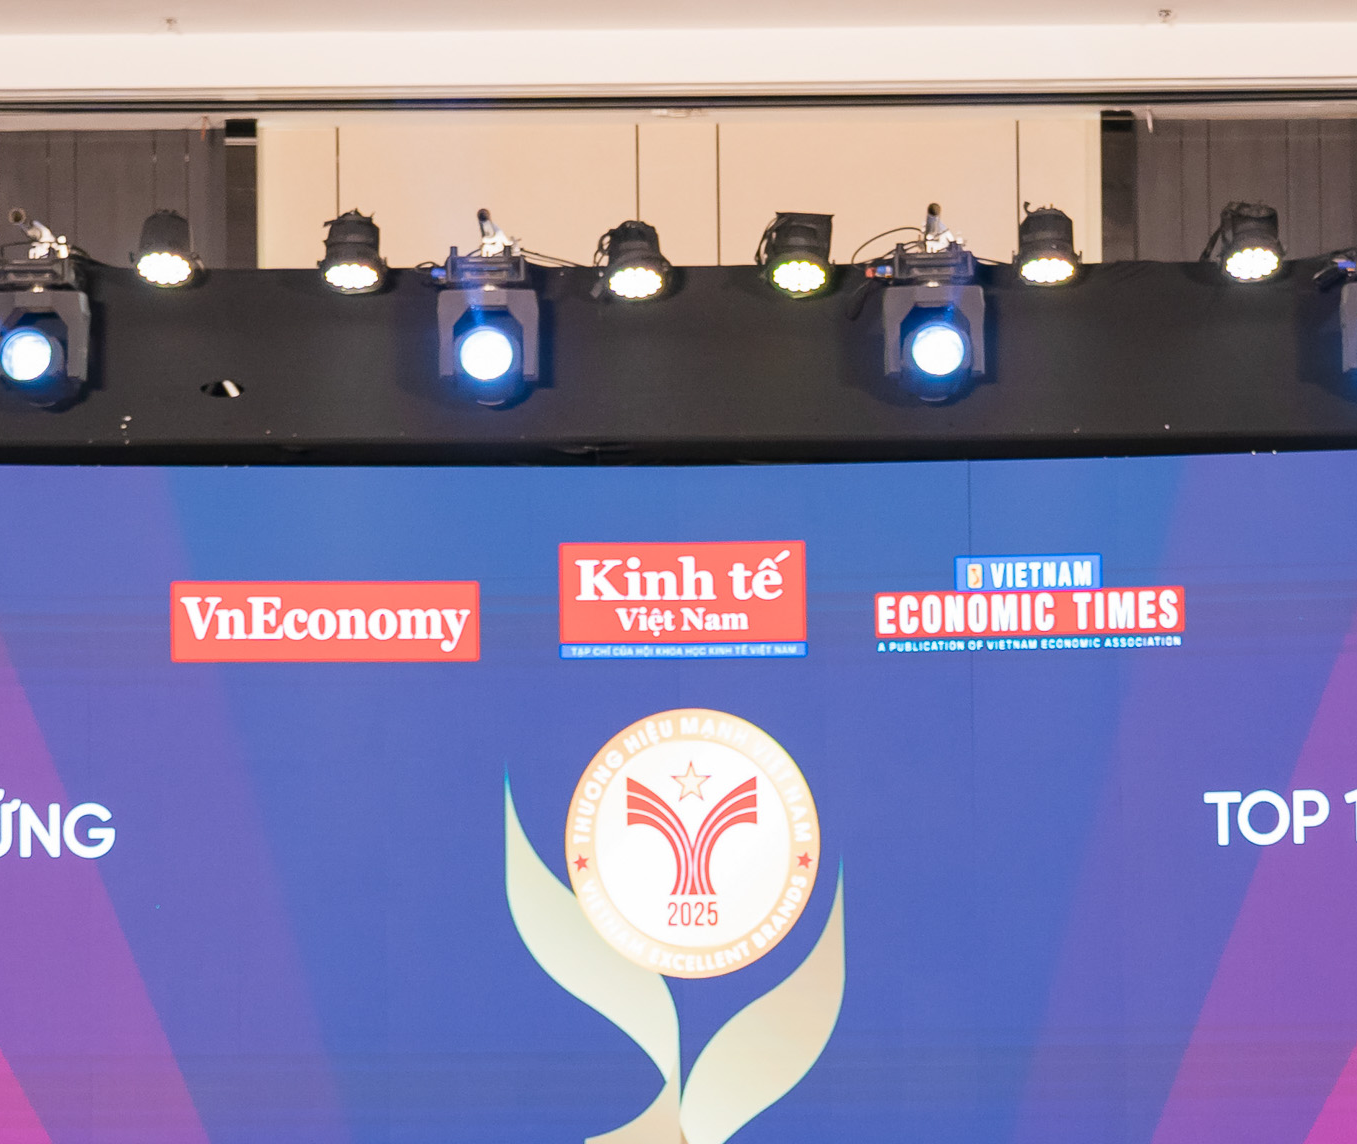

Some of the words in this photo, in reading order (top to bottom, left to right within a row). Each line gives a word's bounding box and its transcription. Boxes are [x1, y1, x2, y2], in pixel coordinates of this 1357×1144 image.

[574, 555, 717, 601] Kinh
[727, 549, 791, 601] tế
[989, 560, 1093, 589] VIETNAM
[179, 596, 471, 653] VnEconomy
[615, 606, 676, 637] Việt
[680, 607, 749, 631] Nam
[877, 592, 1055, 634] ECONOMIC
[1072, 589, 1178, 630] TIMES
[877, 641, 887, 653] A
[888, 639, 966, 653] PUBLICATION
[967, 639, 984, 651] OF
[986, 638, 1038, 651] VIETNAM
[1040, 636, 1101, 650] ECONOMIC
[1103, 635, 1182, 648] ASSOCIATION
[1203, 789, 1330, 846] TOP
[666, 900, 719, 927] 2025
[750, 874, 808, 951] BRANDS
